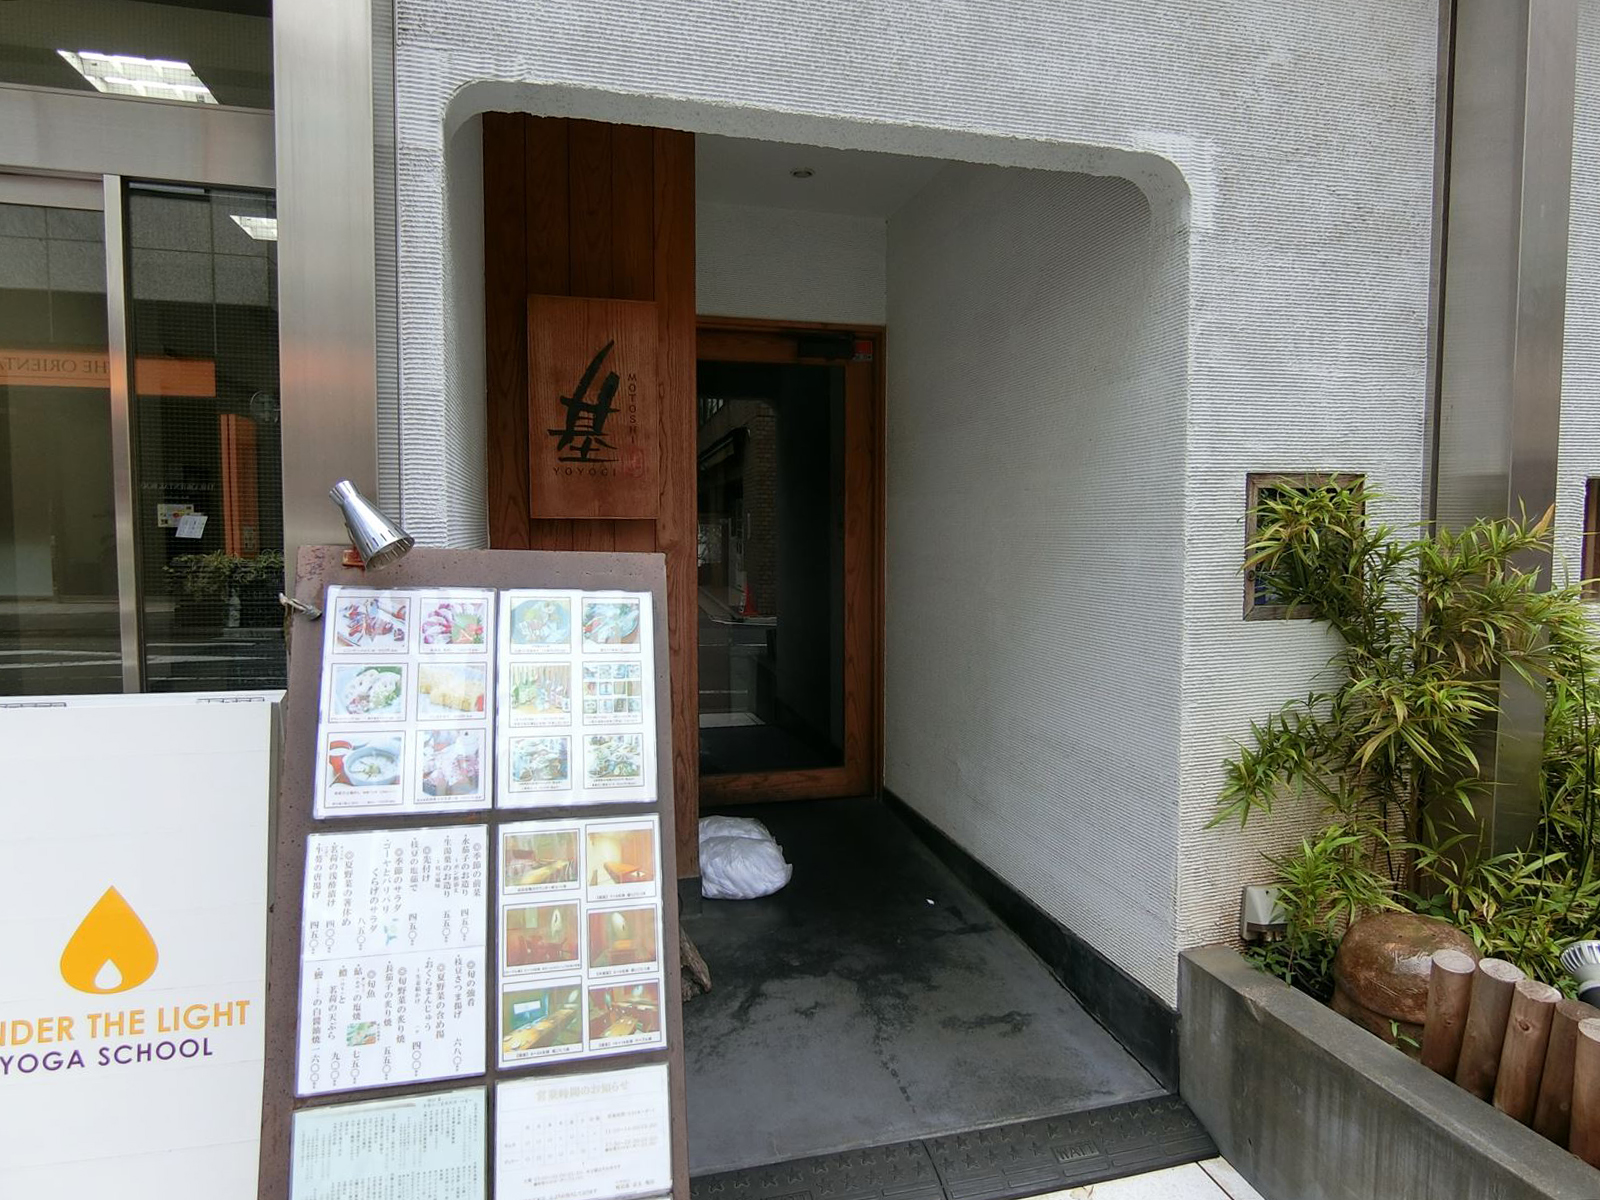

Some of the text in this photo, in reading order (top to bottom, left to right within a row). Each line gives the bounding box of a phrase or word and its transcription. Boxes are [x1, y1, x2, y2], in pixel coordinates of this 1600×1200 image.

[627, 372, 637, 445] MOTOSHI
[552, 466, 617, 477] YOYOGI
[0, 1000, 250, 1047] DER THE LIGHT
[0, 1037, 214, 1075] YOGA SCHOOL
